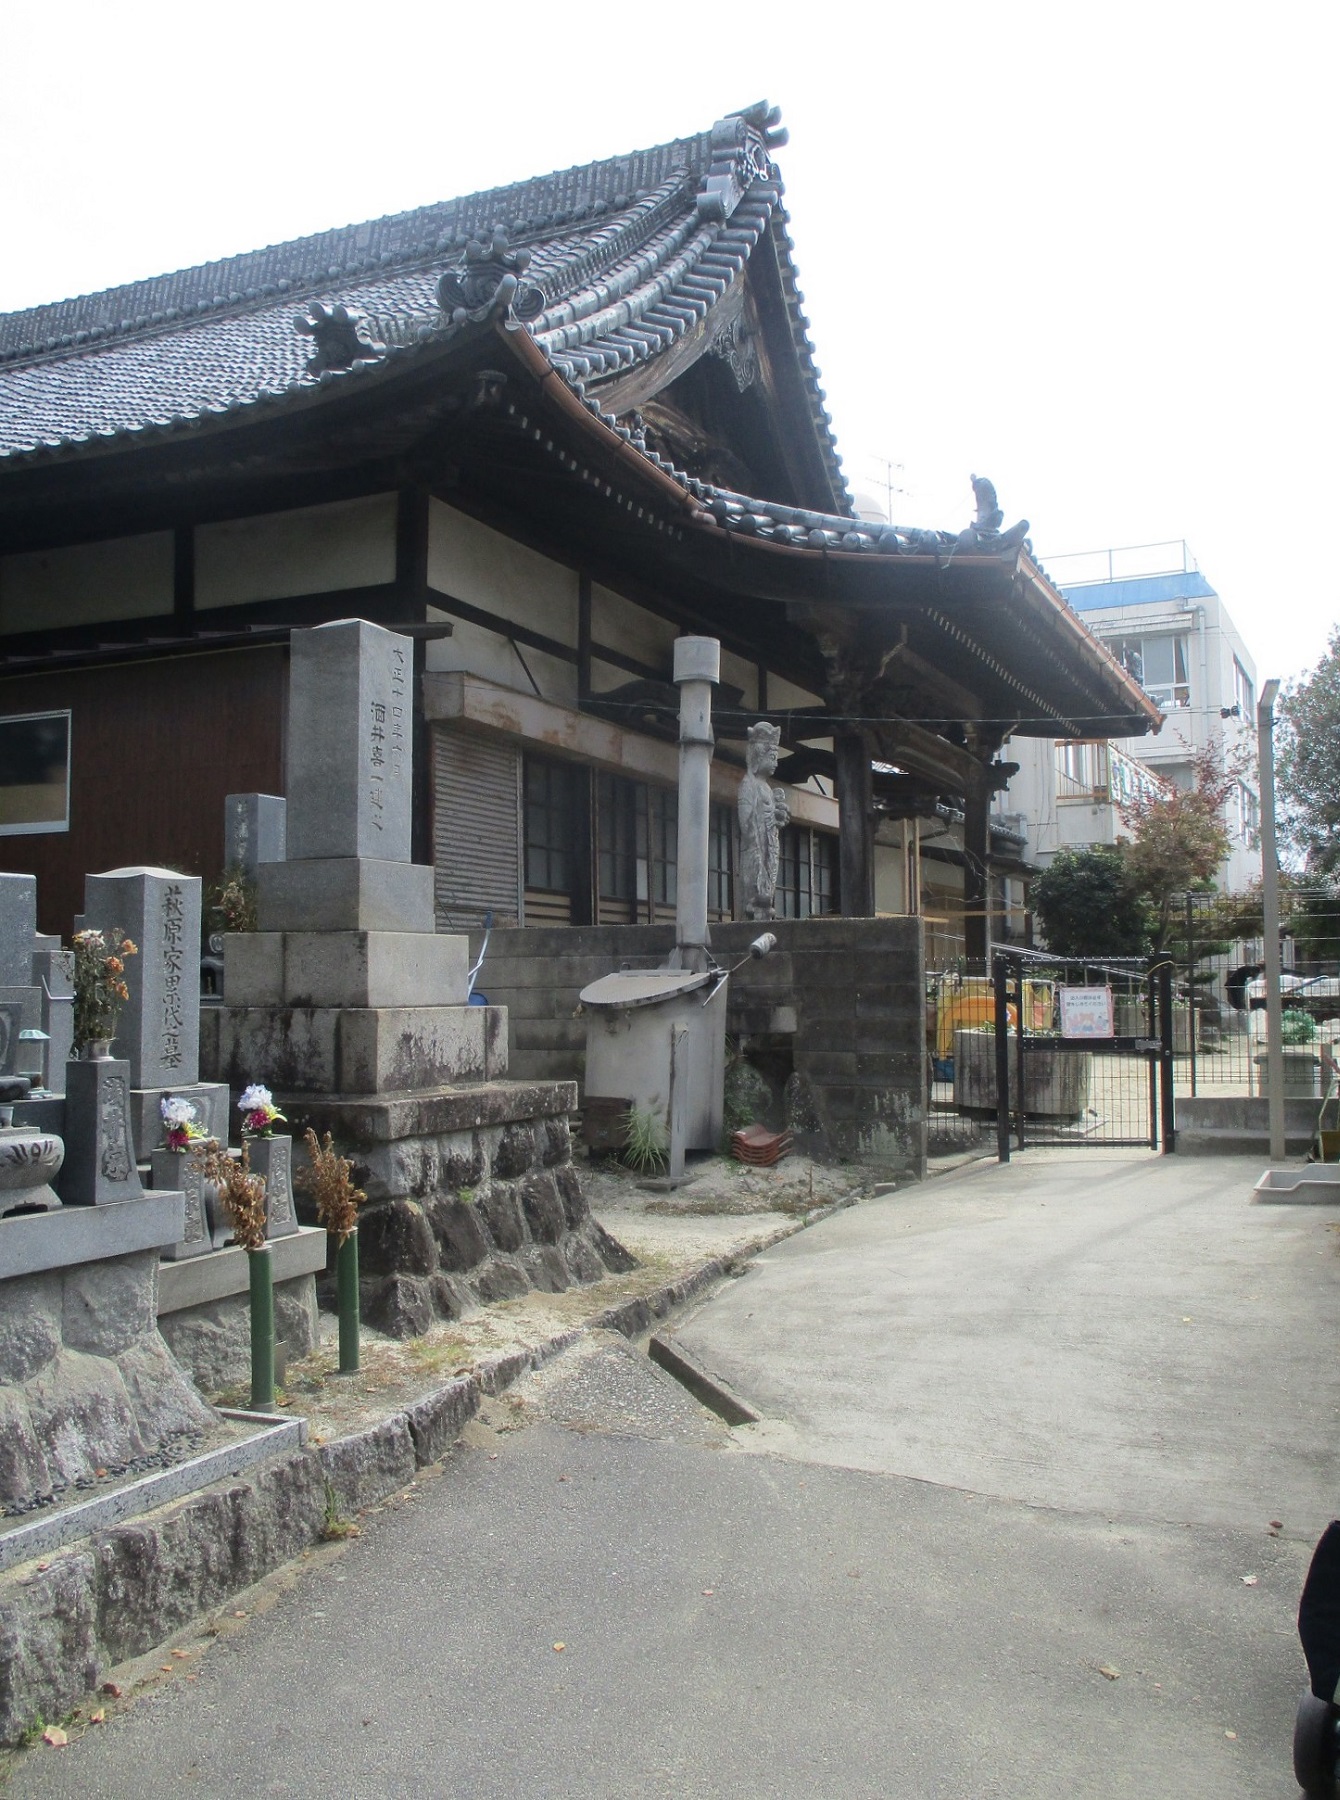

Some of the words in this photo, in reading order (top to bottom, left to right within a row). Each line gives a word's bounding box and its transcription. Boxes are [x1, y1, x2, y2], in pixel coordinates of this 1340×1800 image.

[160, 885, 184, 1070] 萩原家累代之墓
